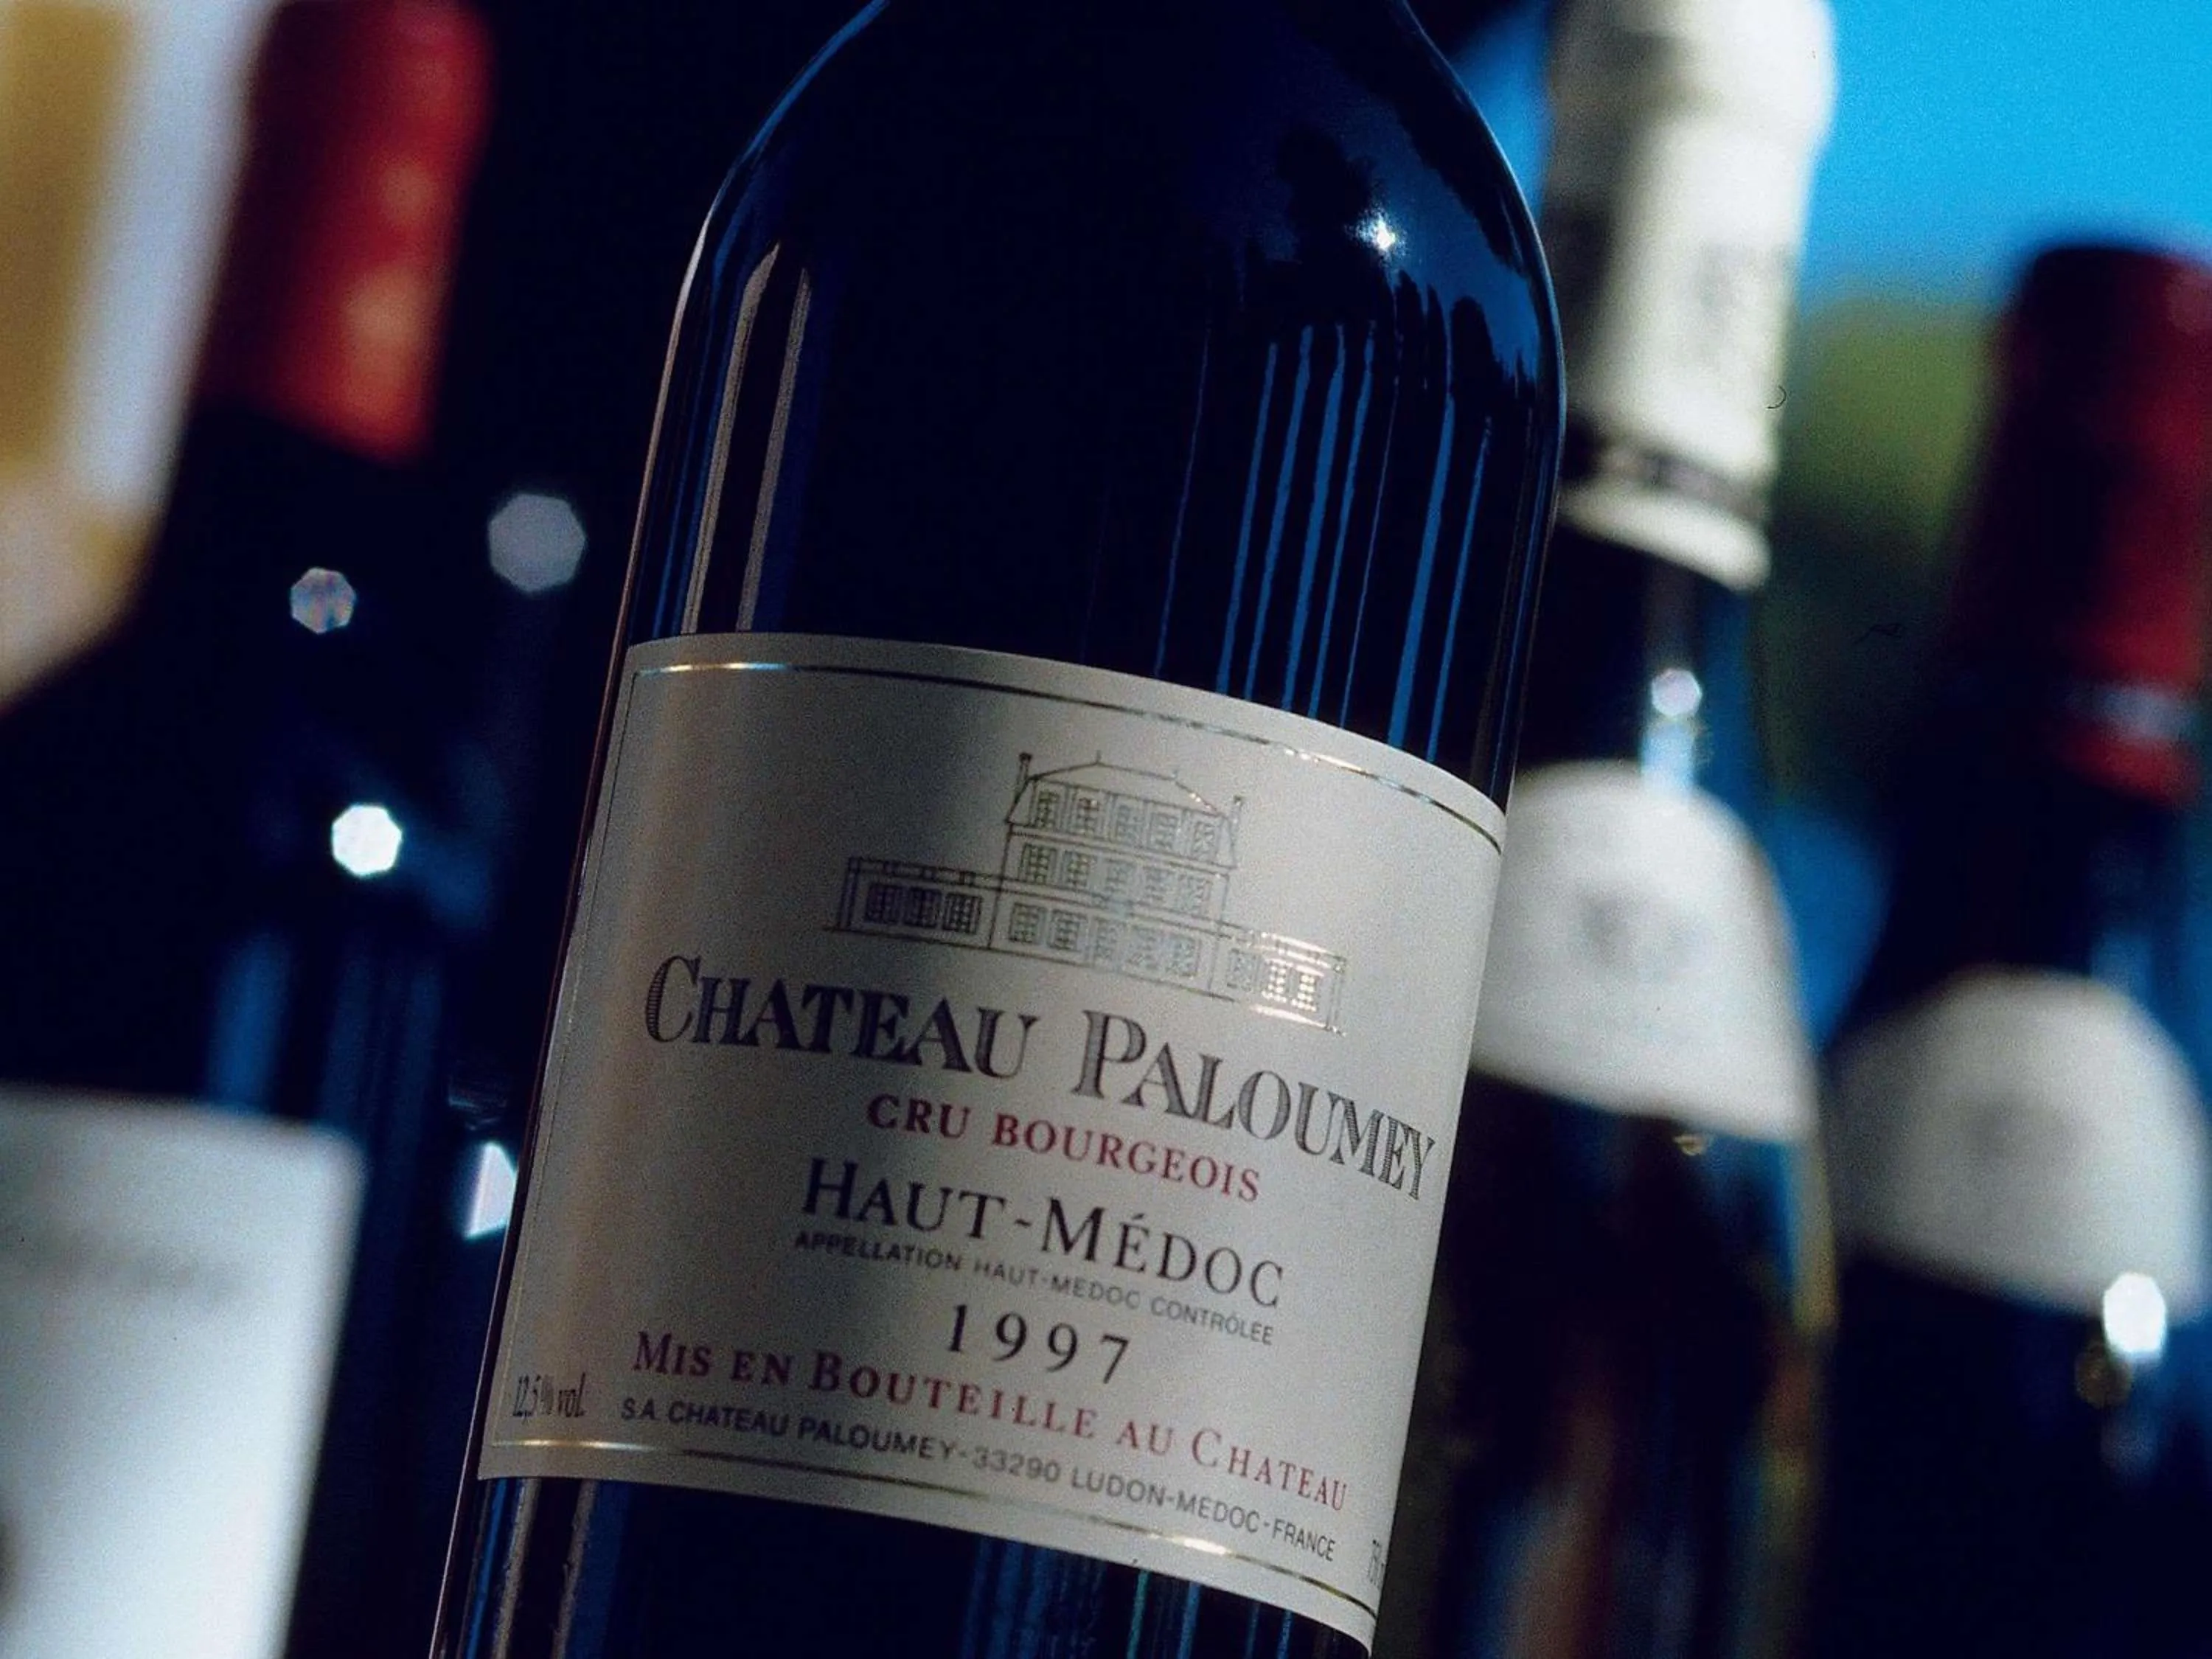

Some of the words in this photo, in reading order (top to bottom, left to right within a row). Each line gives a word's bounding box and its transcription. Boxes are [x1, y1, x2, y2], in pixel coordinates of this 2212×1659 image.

[644, 956, 1040, 1079] CHATEAU
[1071, 1009, 1436, 1200] PALOUMEY
[867, 1094, 971, 1139] CRU
[992, 1113, 1260, 1203] BOURGEOIS
[795, 1231, 960, 1270] APPELLATION
[803, 1157, 1284, 1307] HAUT-MÉDOC
[948, 1304, 1130, 1384] 1997
[633, 1329, 712, 1377] MIS
[730, 1350, 793, 1385] EN
[810, 1351, 1098, 1439] BOUTEILLE
[1116, 1422, 1175, 1456] AU
[1192, 1427, 1348, 1512] CHATEAU
[668, 1400, 788, 1436] CHATEAU
